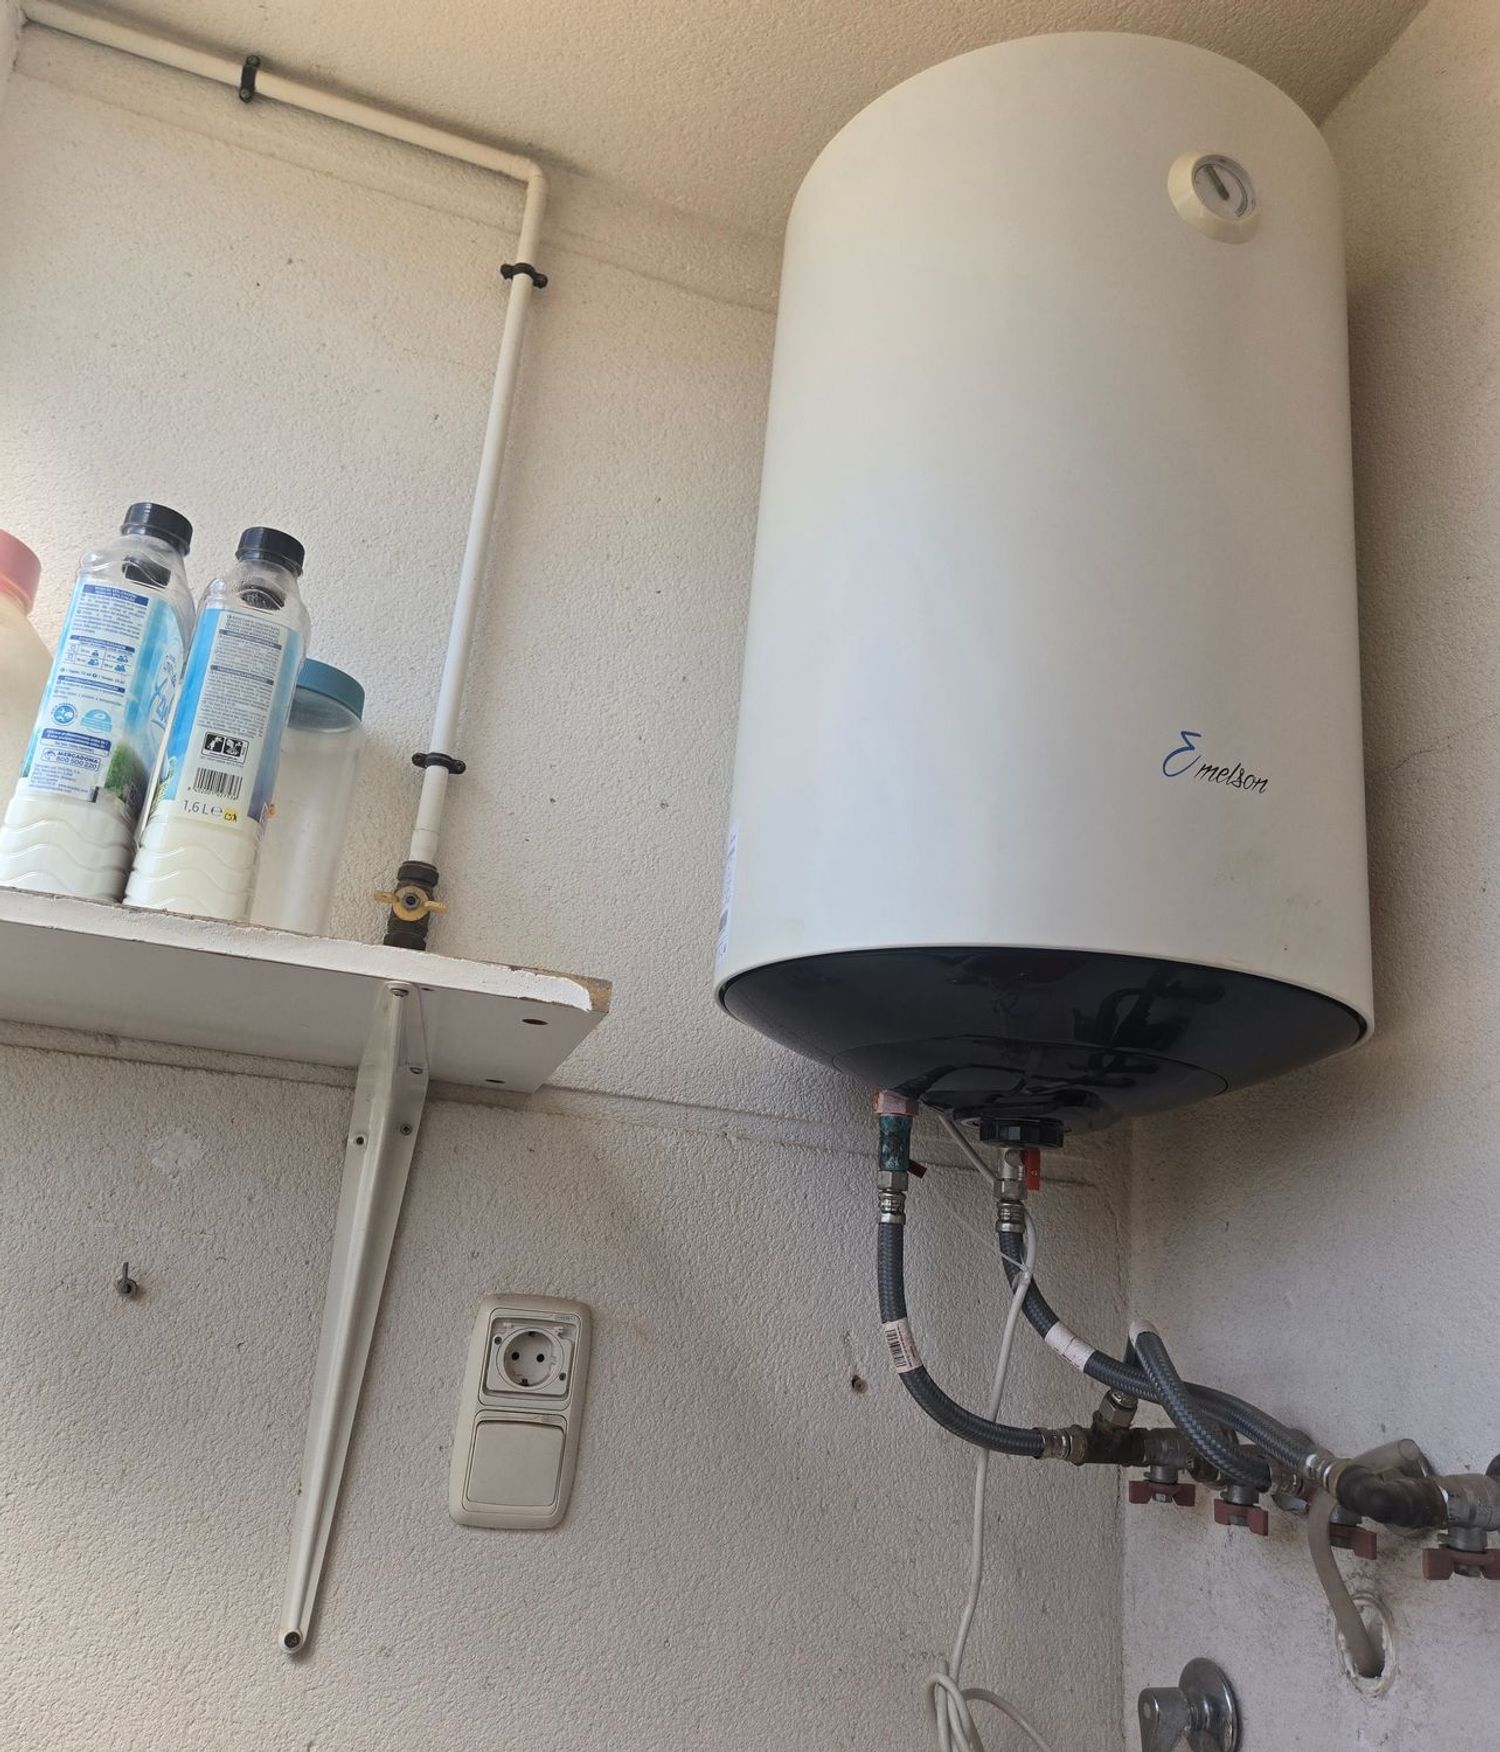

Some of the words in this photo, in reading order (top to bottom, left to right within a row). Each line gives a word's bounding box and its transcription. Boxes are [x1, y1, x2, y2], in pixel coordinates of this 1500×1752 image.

[57, 751, 99, 764] MERCADONA
[1163, 731, 1269, 794] Emelson
[183, 799, 200, 814] 1,6
[202, 803, 208, 816] L
